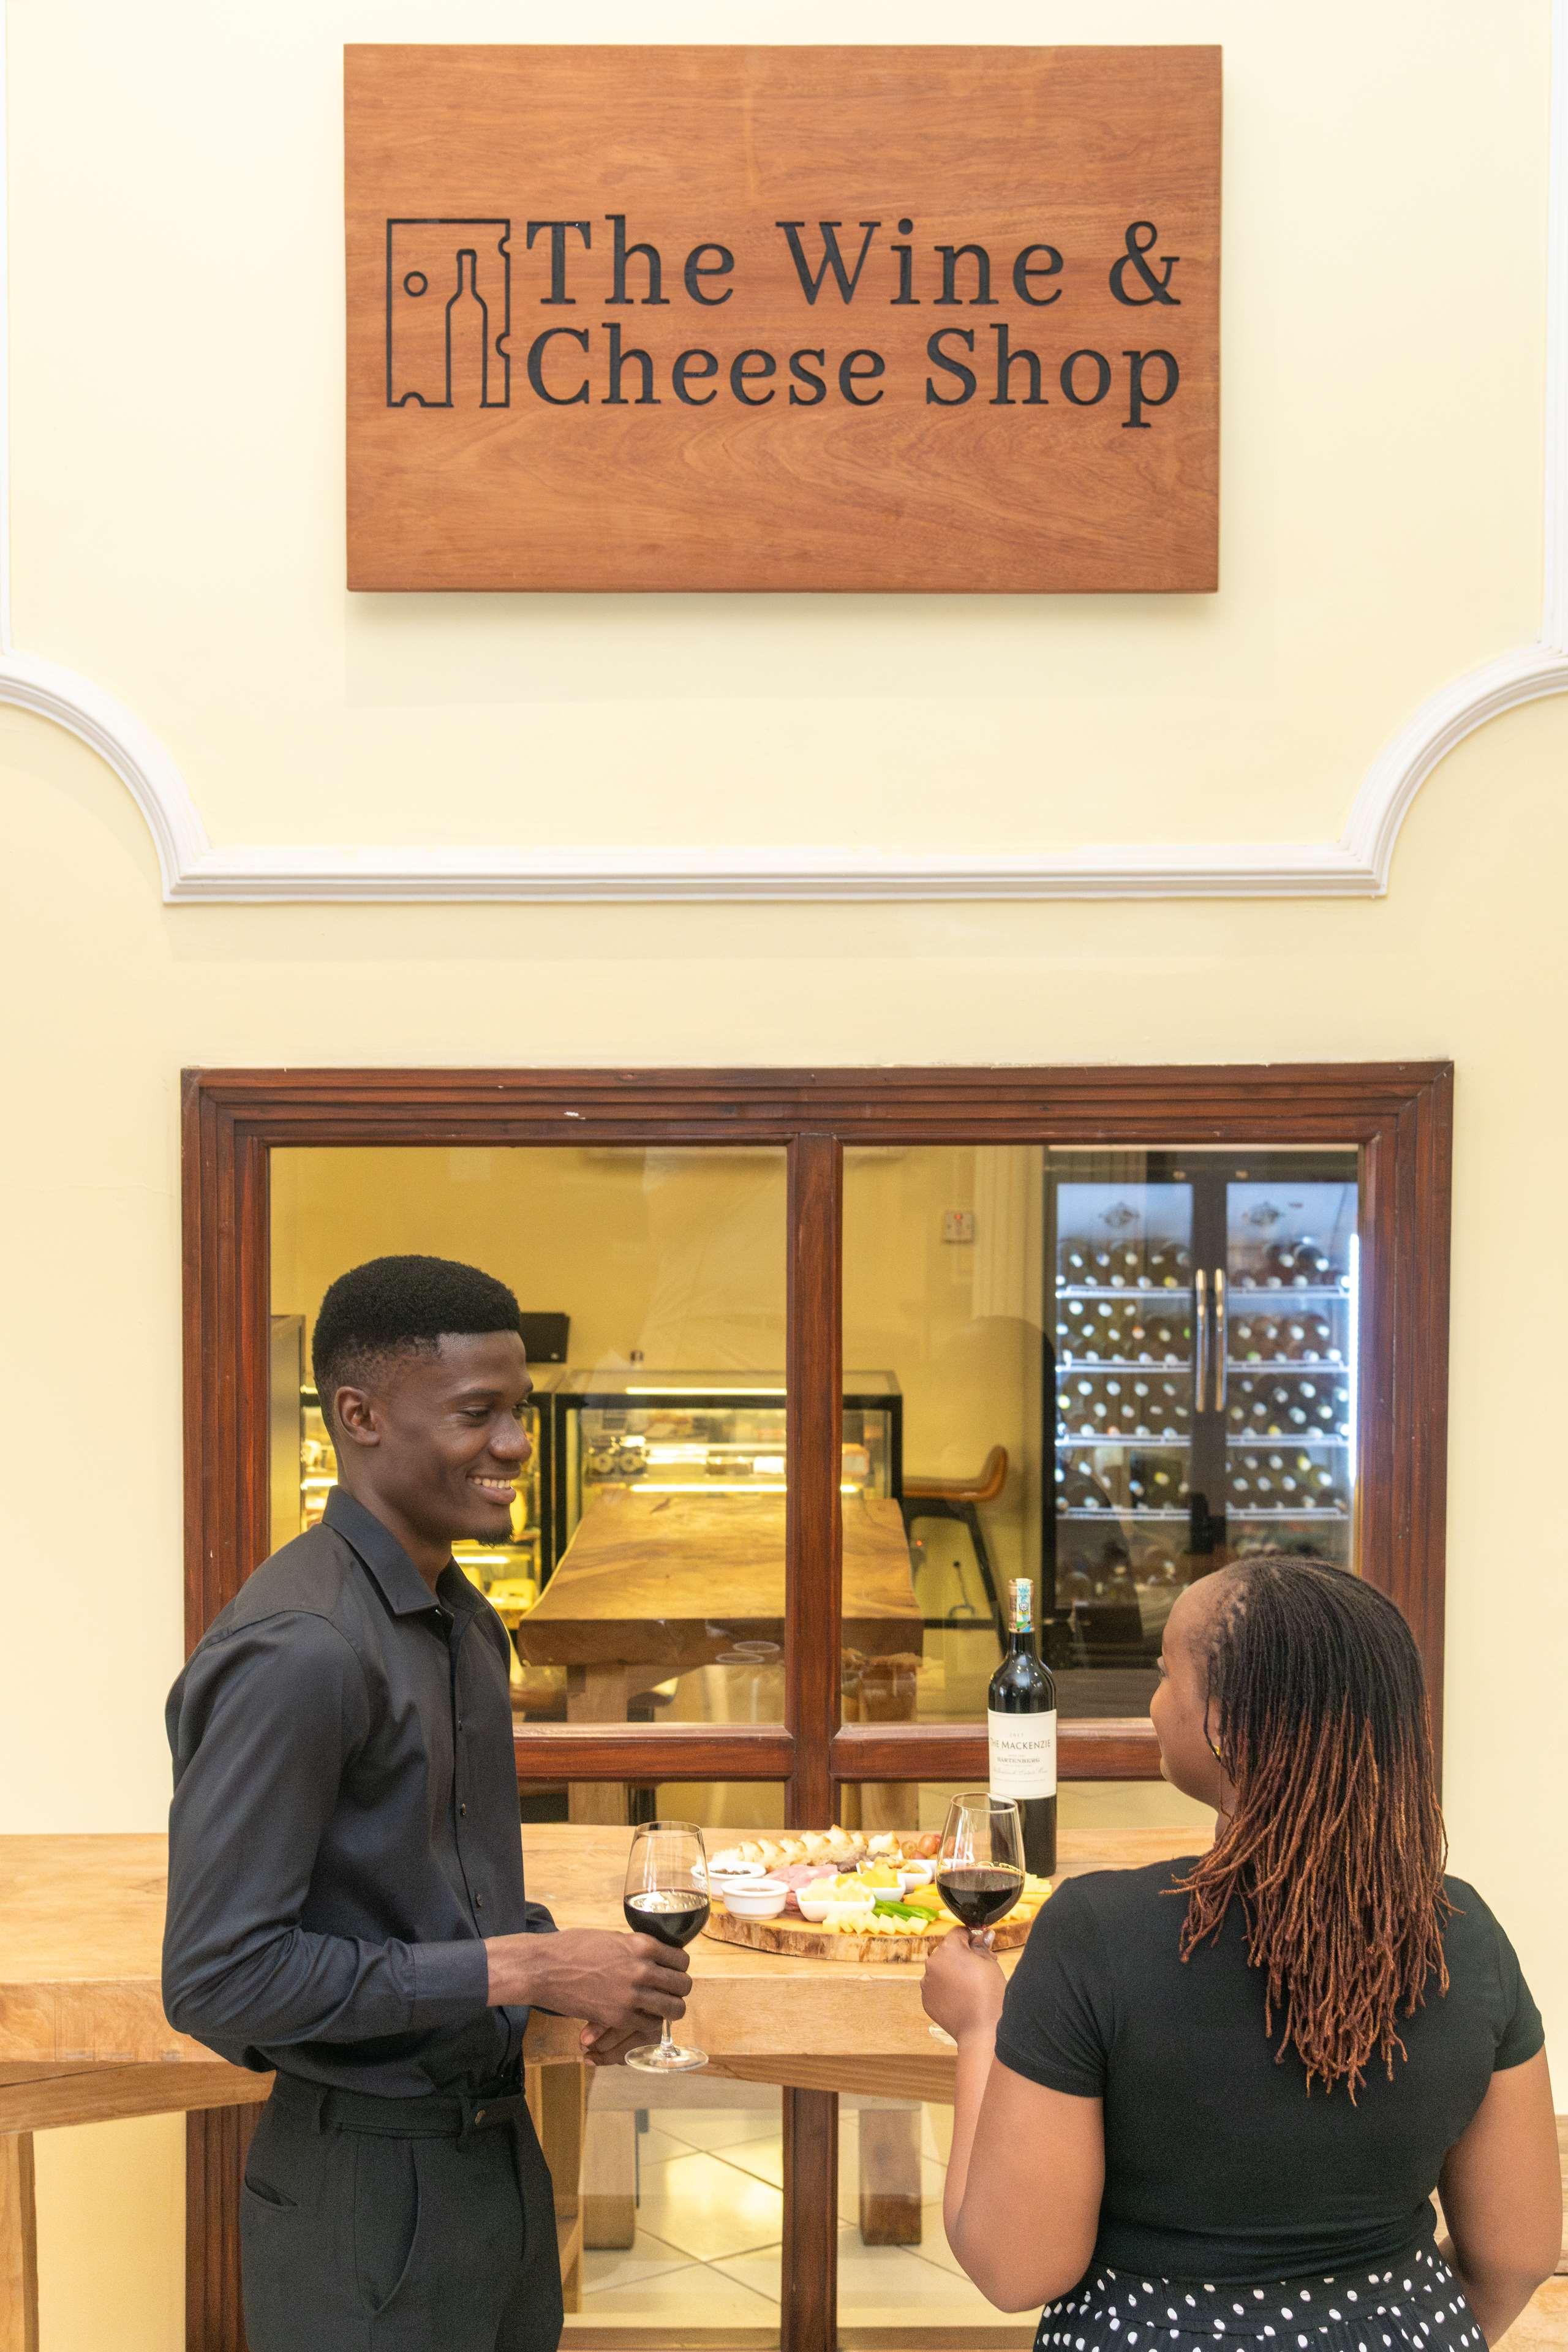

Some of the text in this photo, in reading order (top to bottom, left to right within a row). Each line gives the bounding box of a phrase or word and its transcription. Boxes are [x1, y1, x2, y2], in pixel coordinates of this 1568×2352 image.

[526, 214, 1182, 307] The Wine &
[527, 322, 1180, 429] Cheese Shop
[1001, 1739, 1051, 1750] MACKENZIE
